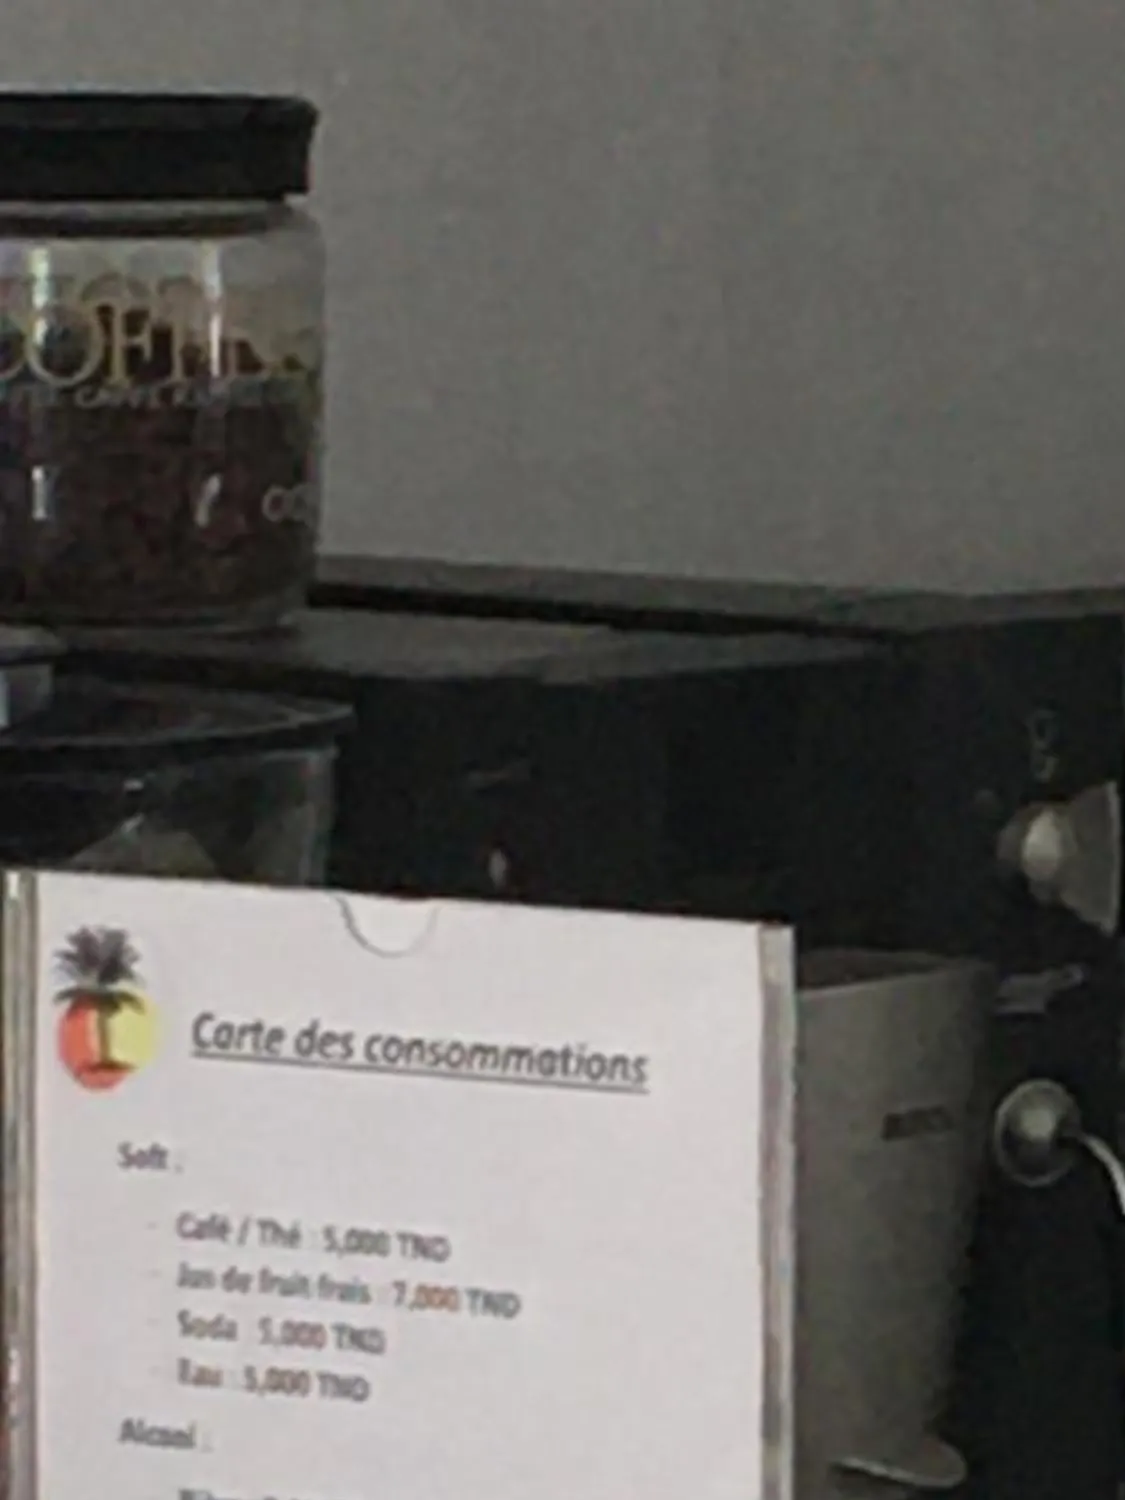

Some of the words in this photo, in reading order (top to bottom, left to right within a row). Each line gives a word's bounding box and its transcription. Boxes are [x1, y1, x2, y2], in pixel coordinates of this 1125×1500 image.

[191, 1011, 287, 1055] Carte
[293, 1019, 355, 1060] des
[363, 1033, 649, 1085] consommations
[118, 1142, 169, 1170] Soft
[176, 1212, 232, 1243] Café
[256, 1218, 302, 1249] Thé
[396, 1231, 451, 1263] TND
[221, 1266, 252, 1294] de
[464, 1288, 521, 1320] TND
[177, 1309, 237, 1341] Soda
[330, 1323, 386, 1355] TND
[177, 1357, 223, 1388] Eau
[316, 1371, 371, 1403] TND
